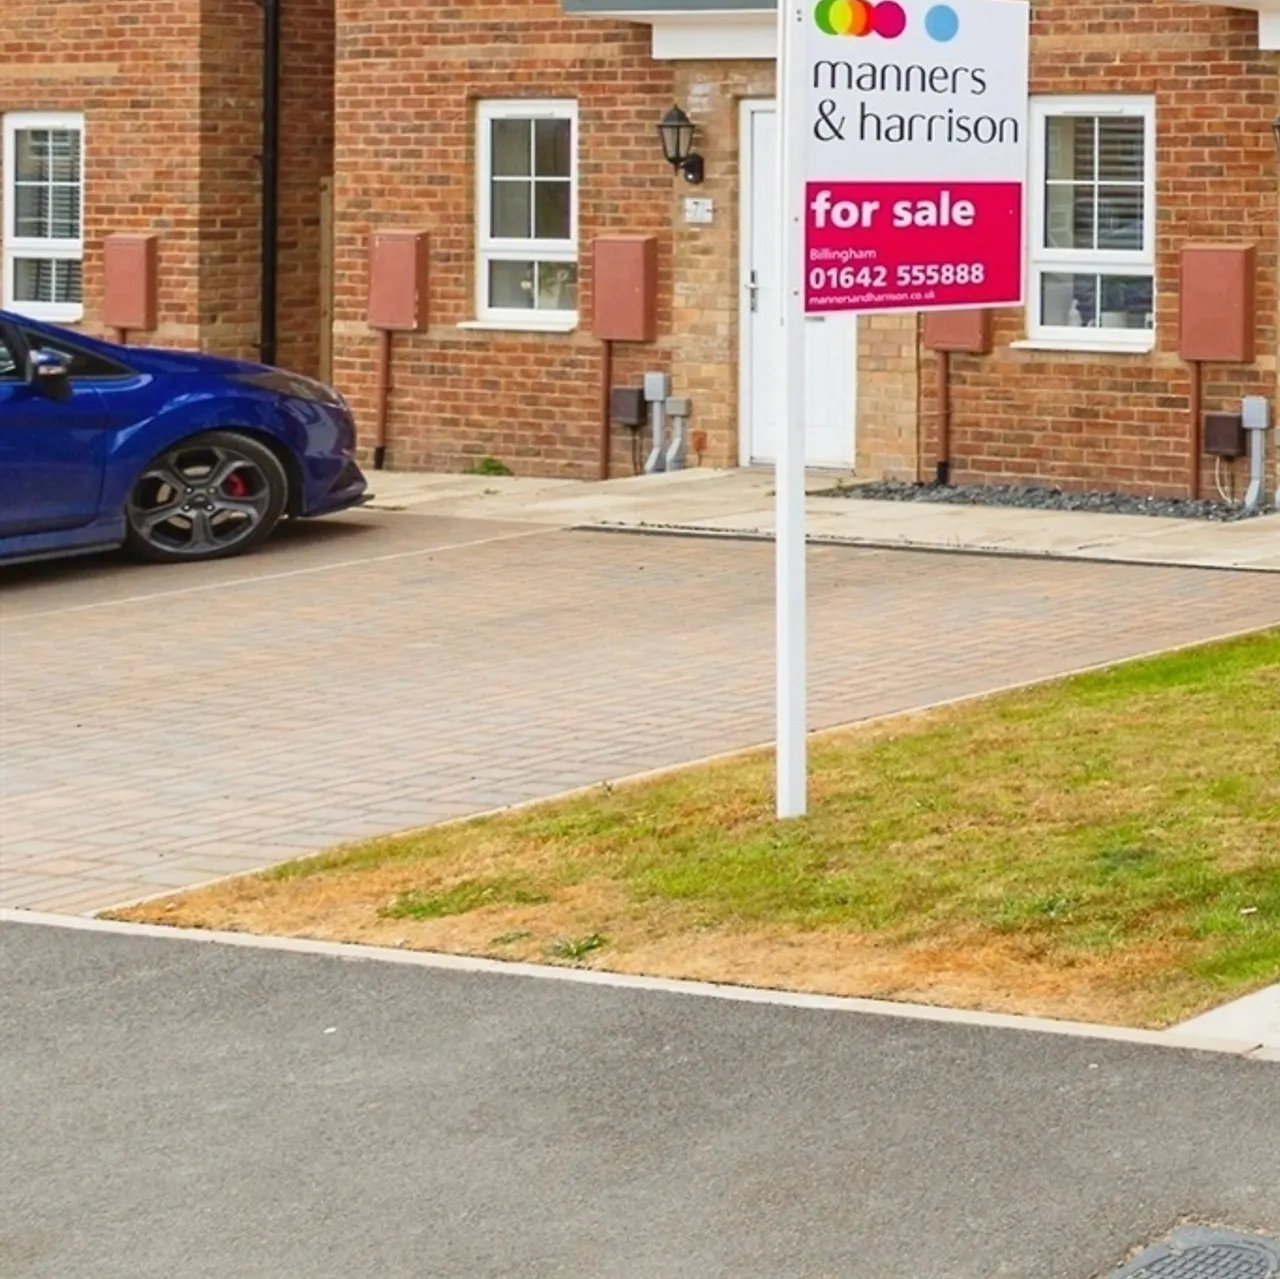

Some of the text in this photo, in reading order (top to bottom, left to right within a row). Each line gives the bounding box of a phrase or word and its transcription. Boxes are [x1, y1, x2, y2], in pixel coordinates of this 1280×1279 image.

[813, 60, 986, 95] manners
[813, 99, 1019, 143] & harrison
[810, 190, 976, 228] for sale
[809, 248, 877, 263] Billingham
[809, 263, 985, 289] 01642 555888
[808, 290, 935, 305] mannersandharrison.co.uk
